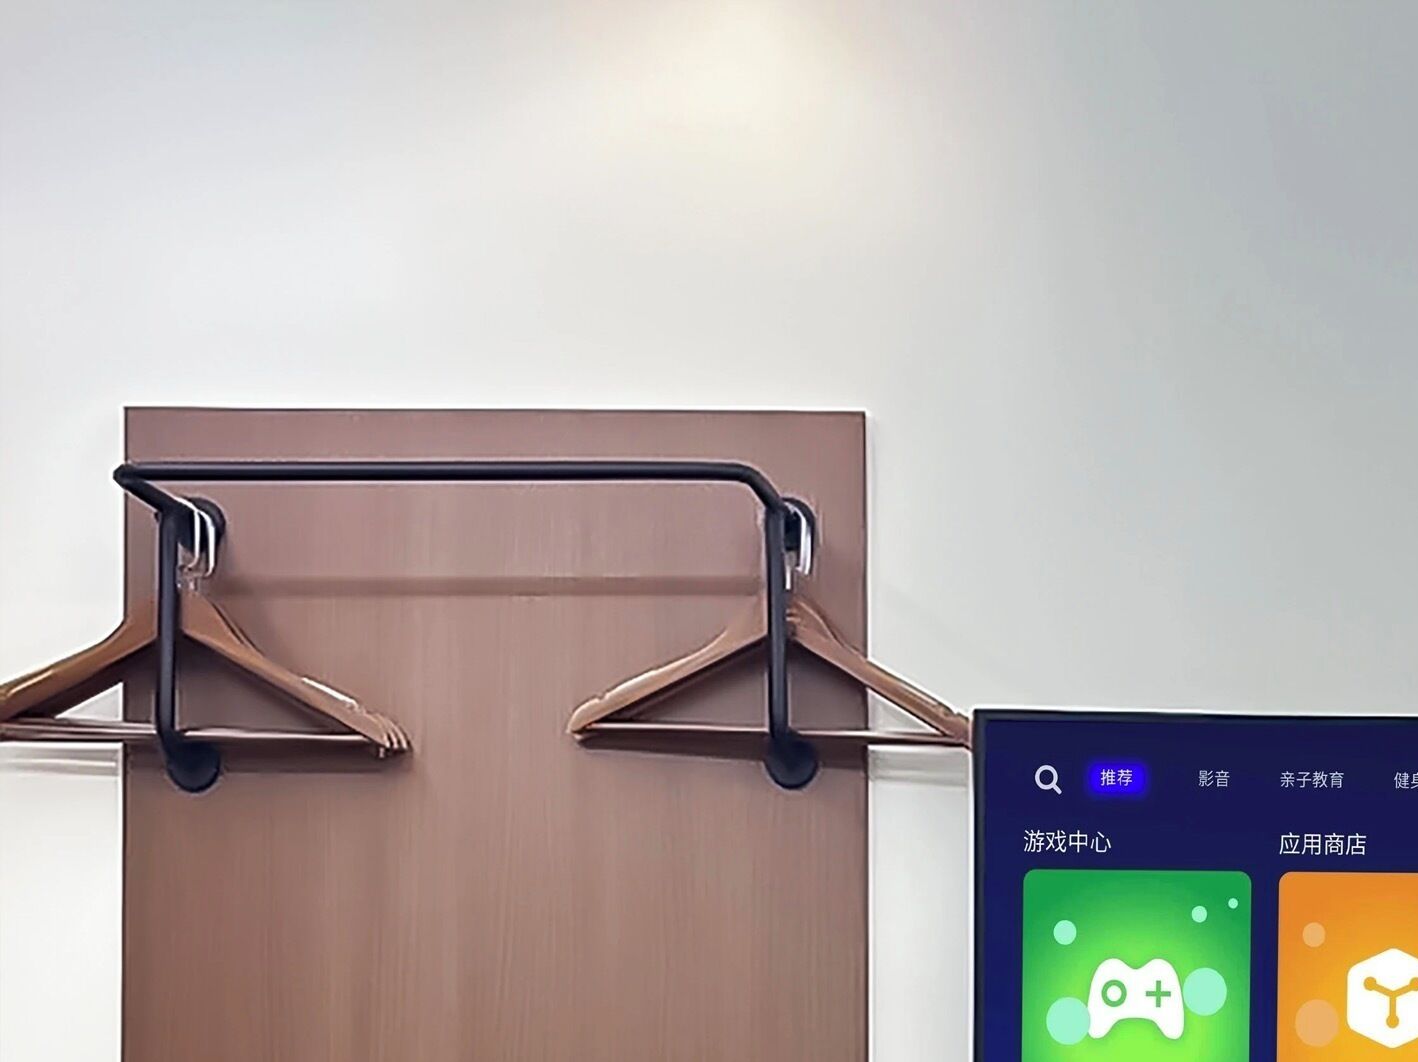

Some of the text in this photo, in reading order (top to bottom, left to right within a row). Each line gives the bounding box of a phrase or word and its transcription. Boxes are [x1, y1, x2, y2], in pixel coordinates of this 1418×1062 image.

[1100, 768, 1134, 787] 推荐
[1198, 769, 1231, 788] 影音
[1279, 770, 1345, 789] 亲子教育
[1022, 829, 1112, 854] 游戏中心
[1278, 831, 1367, 856] 应用商店
